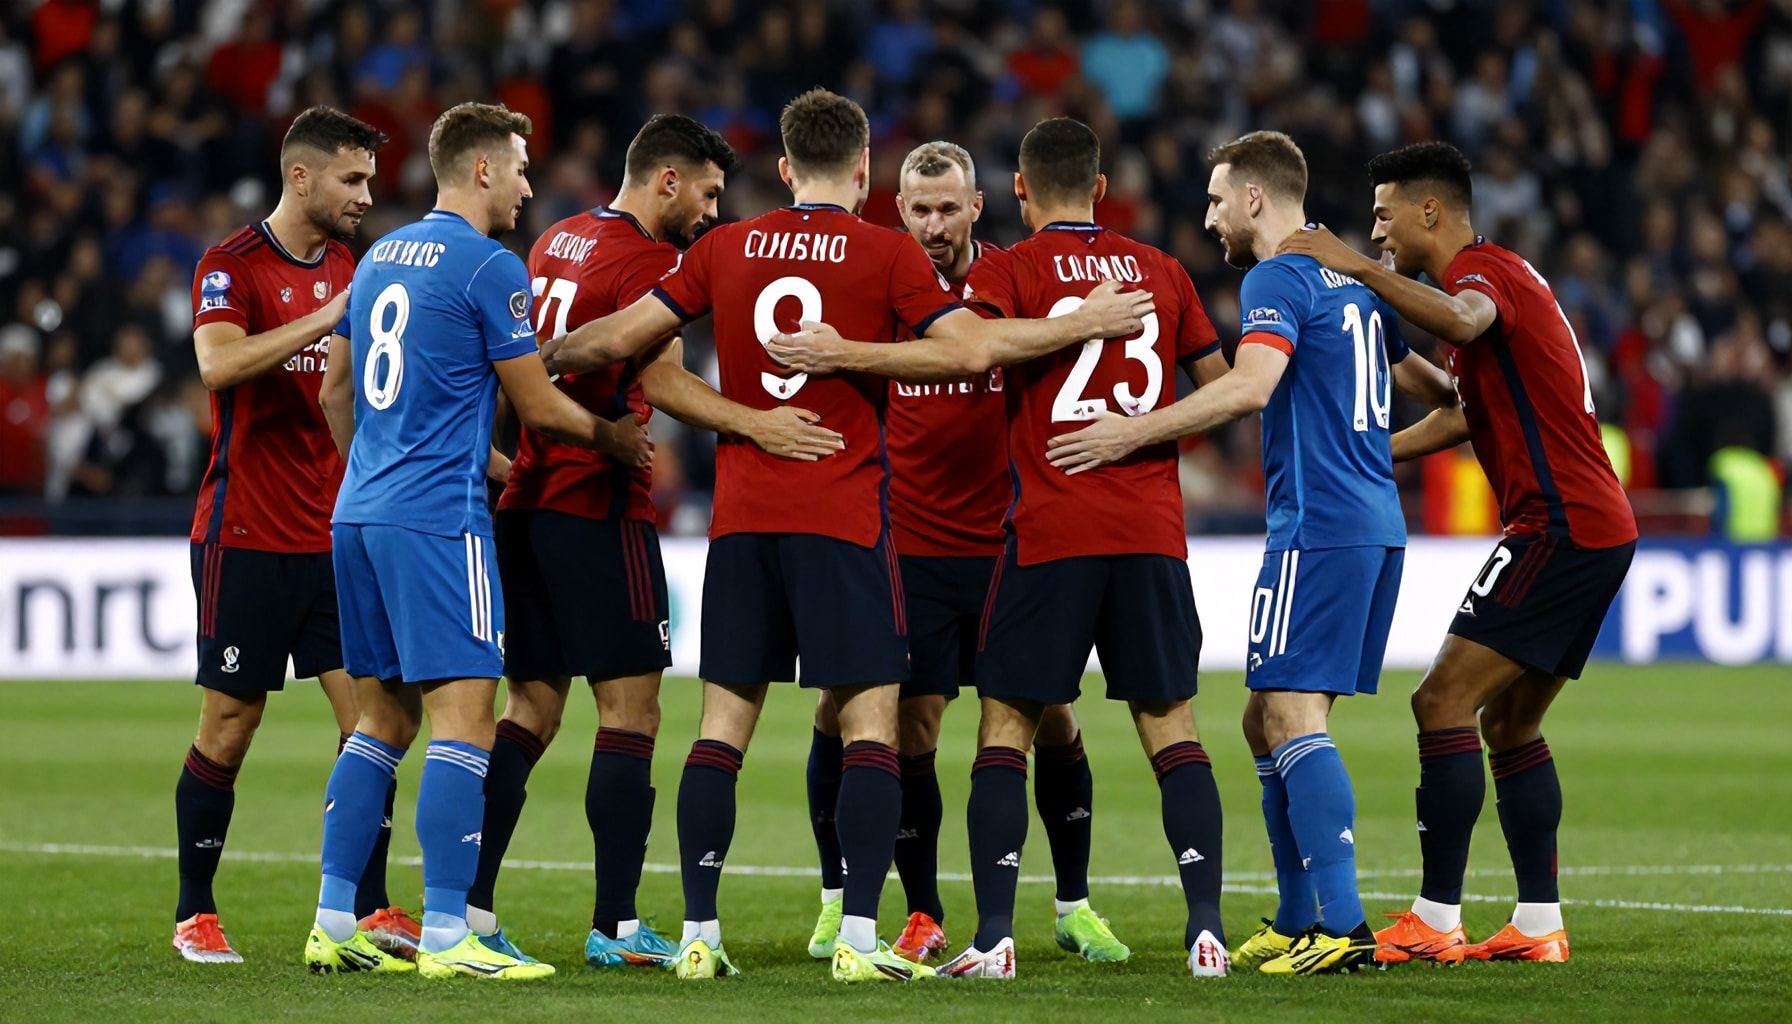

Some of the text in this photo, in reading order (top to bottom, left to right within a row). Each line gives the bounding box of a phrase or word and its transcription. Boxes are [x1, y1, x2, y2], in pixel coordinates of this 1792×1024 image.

[364, 283, 410, 411] 8
[754, 276, 822, 399] 9
[1047, 296, 1163, 423] 23
[1342, 303, 1391, 431] 10
